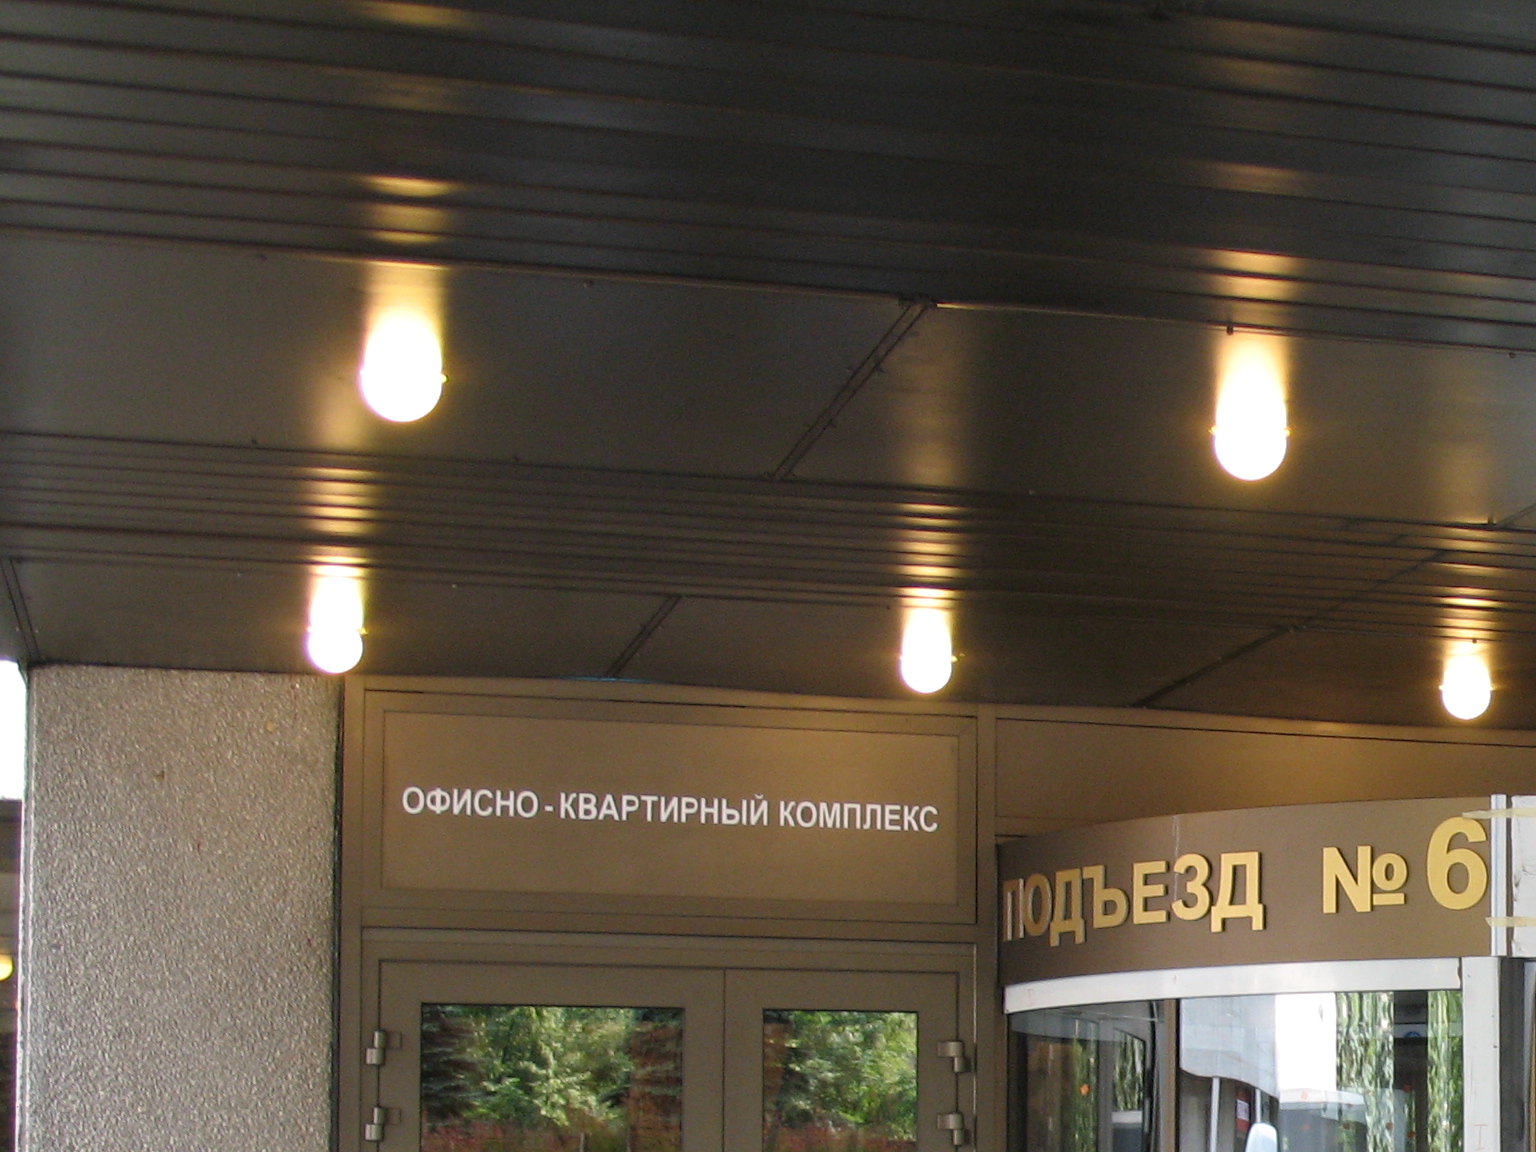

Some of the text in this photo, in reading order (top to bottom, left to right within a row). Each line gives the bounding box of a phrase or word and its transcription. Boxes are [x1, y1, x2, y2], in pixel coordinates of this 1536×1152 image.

[779, 800, 939, 833] КОМПЛЕКС
[1002, 850, 1266, 947] ПОДЪЕЗД
[1426, 815, 1489, 911] 6
